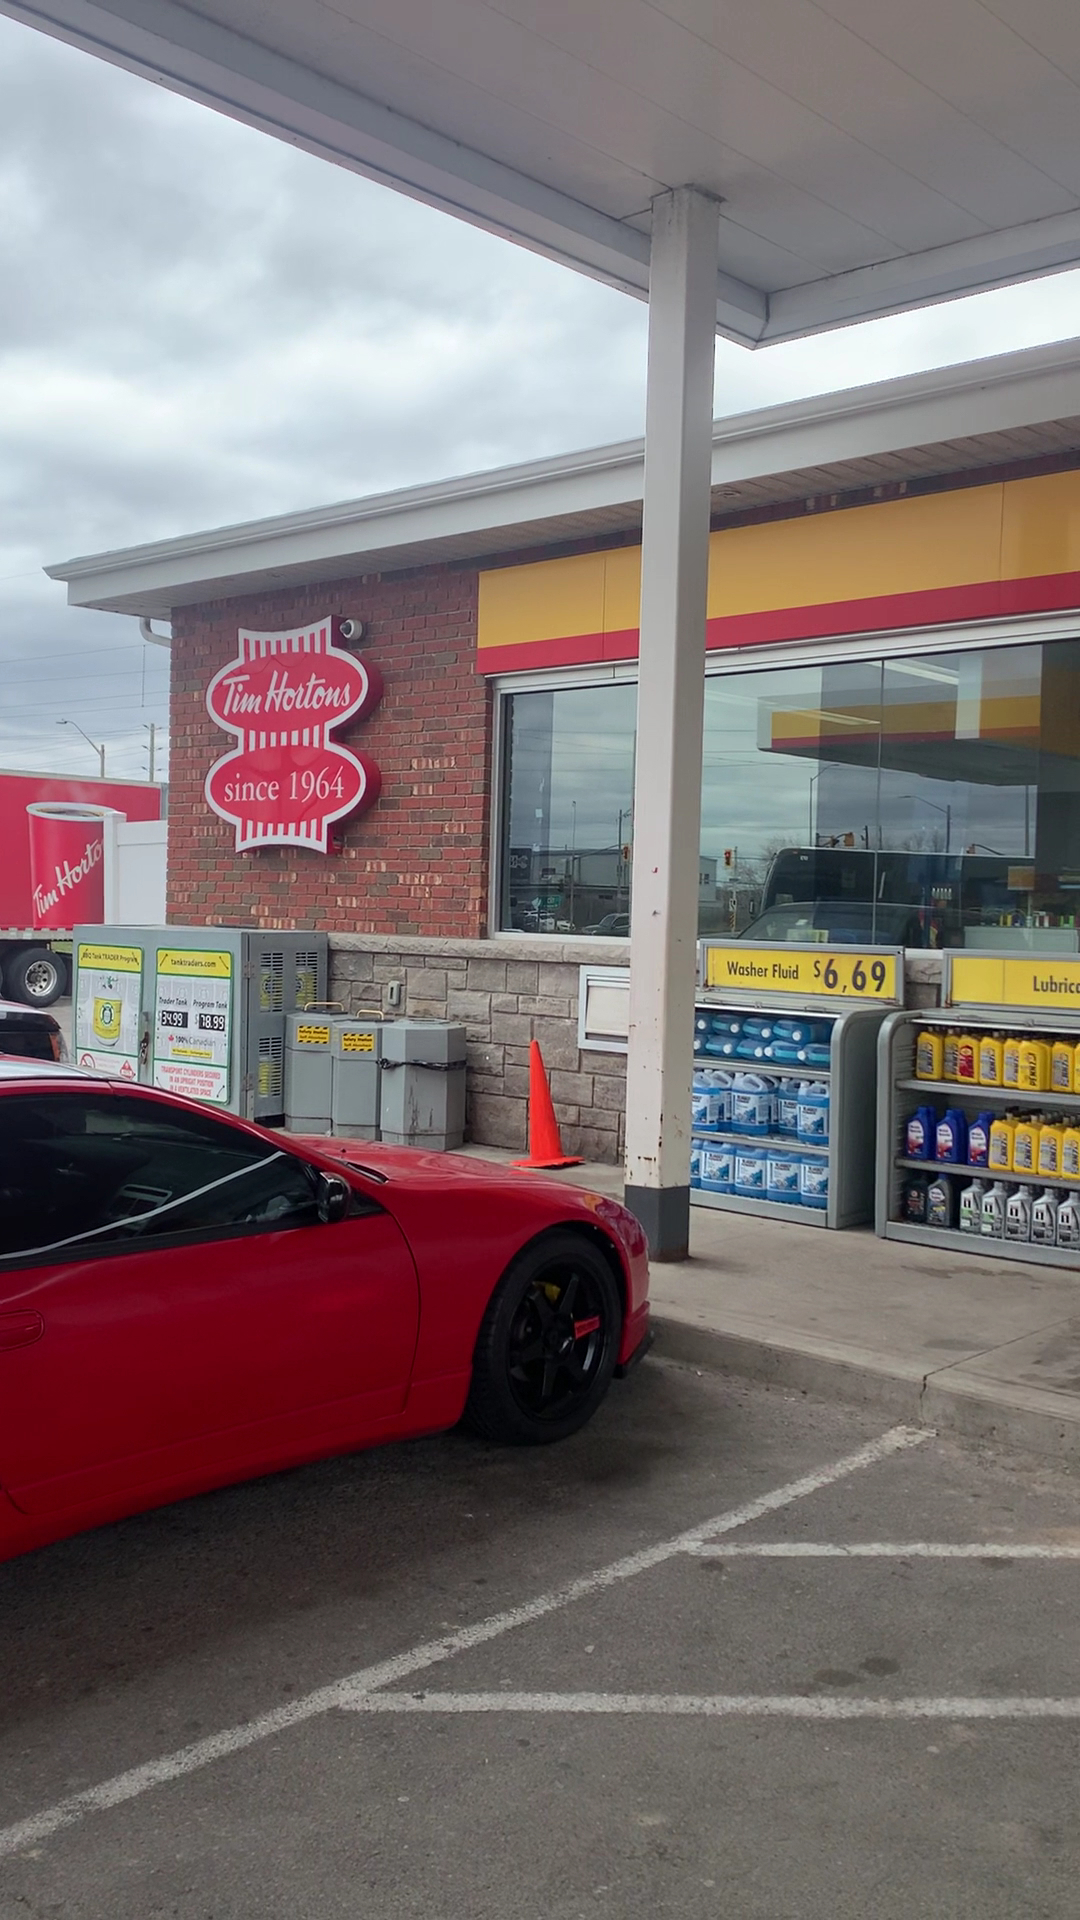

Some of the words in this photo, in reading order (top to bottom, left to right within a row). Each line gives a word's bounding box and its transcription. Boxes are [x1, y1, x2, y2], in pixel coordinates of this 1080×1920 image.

[222, 674, 262, 716] Tim
[264, 670, 350, 712] Hortons
[224, 773, 279, 802] since
[289, 766, 344, 803] 1964
[33, 884, 59, 918] Tim
[171, 958, 216, 968] tanktraders.com
[727, 961, 768, 978] Washer
[772, 963, 799, 980] Fluid
[159, 996, 174, 1006] Trader
[175, 998, 187, 1006] Tank
[193, 999, 215, 1009] Program
[216, 1001, 228, 1009] Tank
